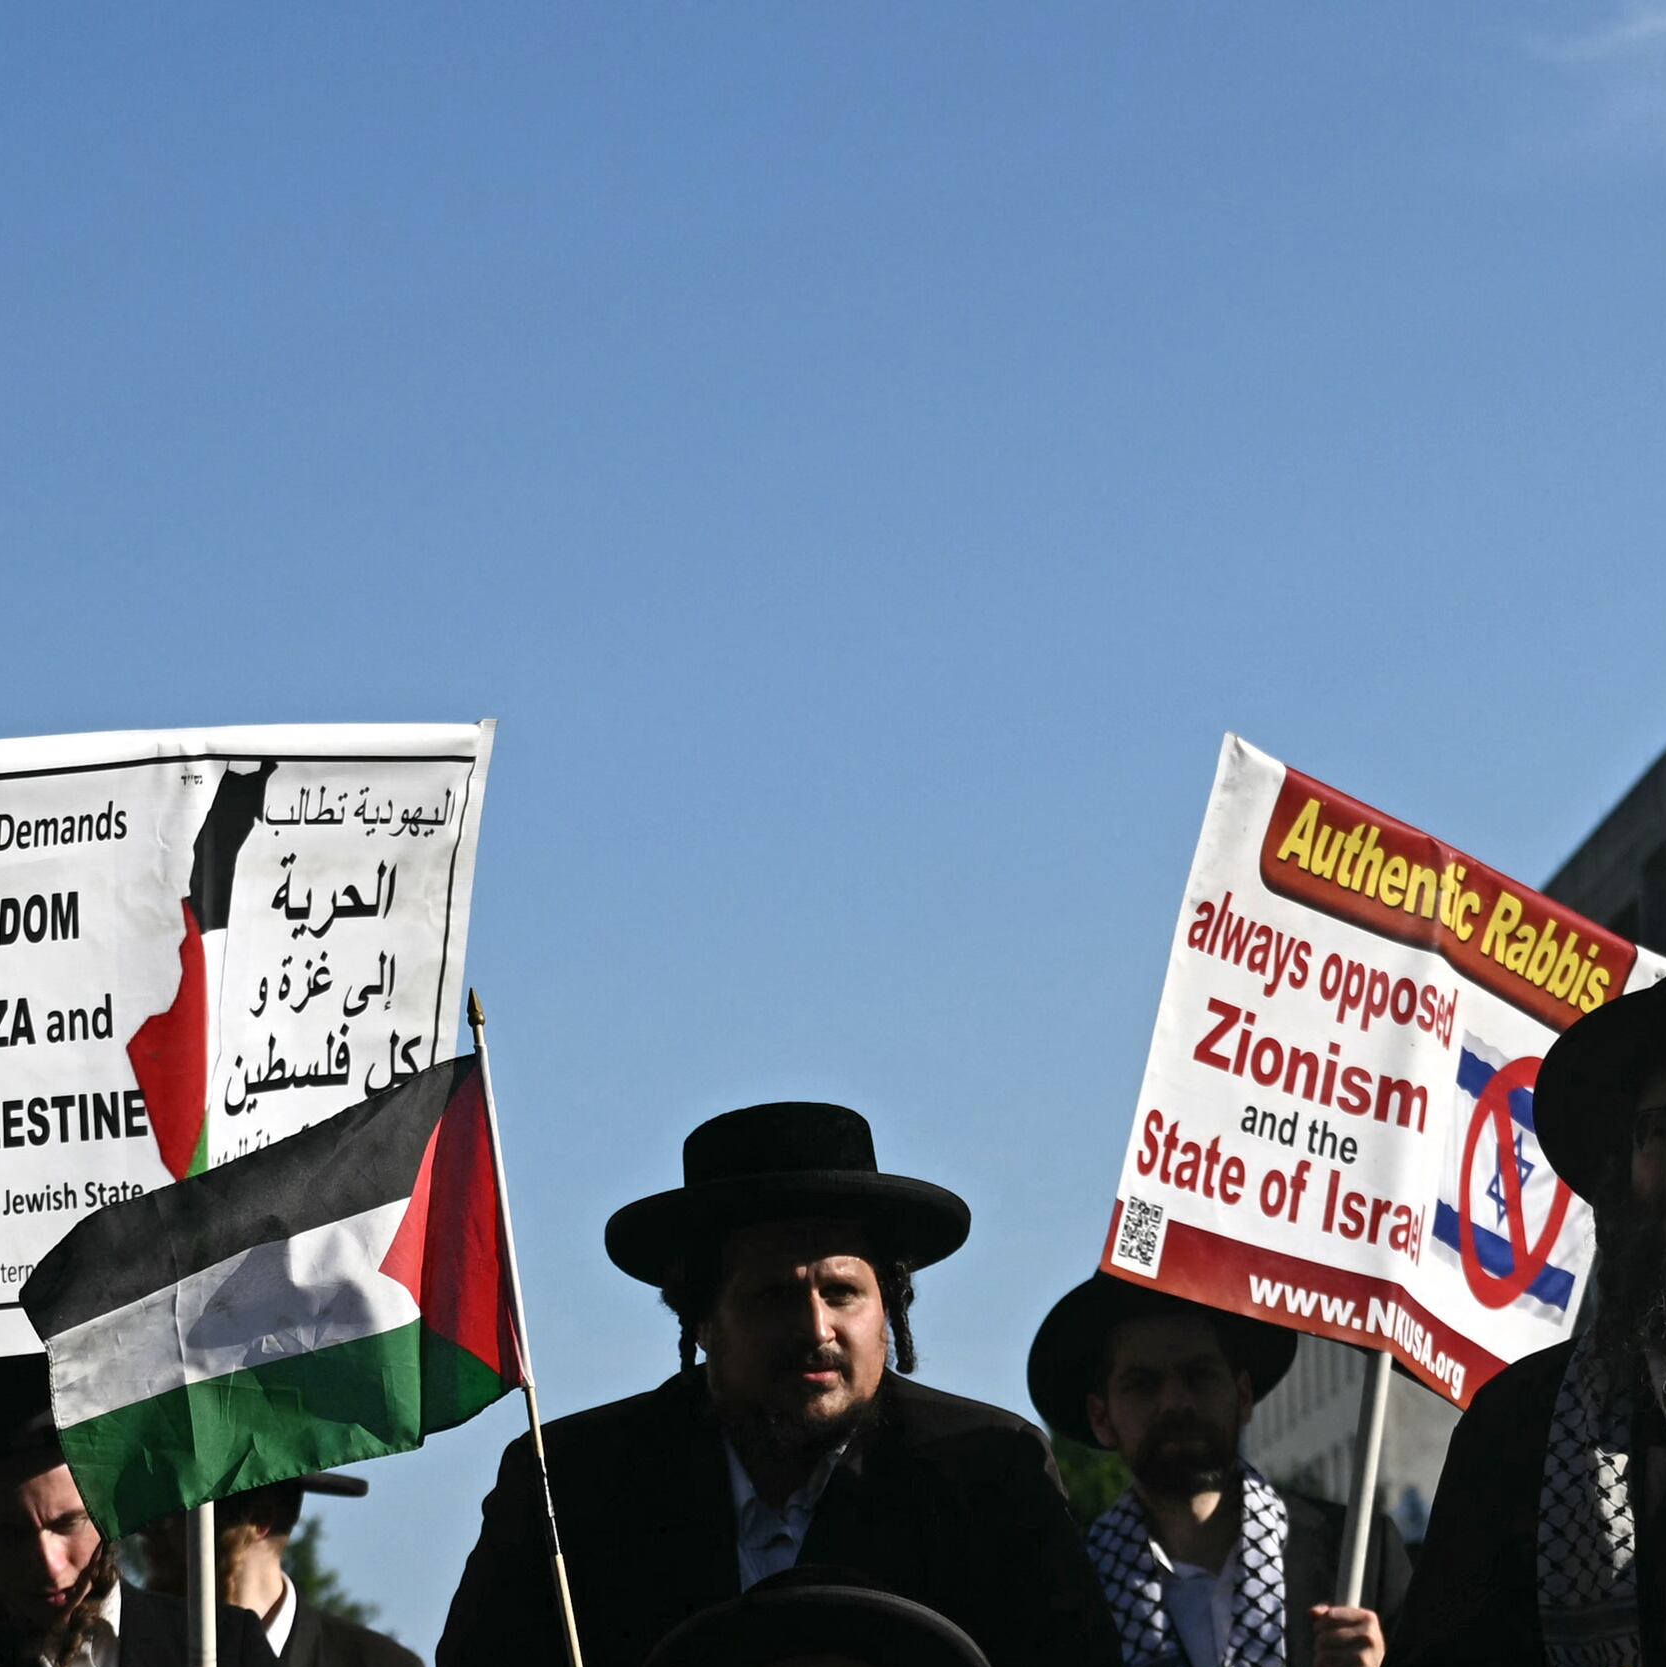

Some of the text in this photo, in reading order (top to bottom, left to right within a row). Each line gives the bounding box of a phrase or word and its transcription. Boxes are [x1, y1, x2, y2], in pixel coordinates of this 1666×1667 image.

[265, 785, 456, 837] اليهودية تطالب
[271, 852, 397, 940] الحرية
[1276, 798, 1611, 1015] Authentic Rabbis
[278, 951, 333, 1013] غزة
[343, 951, 395, 1017] إلى
[1188, 891, 1458, 1050] always opposed
[45, 993, 113, 1046] and
[224, 1023, 351, 1116] فلسطين
[1193, 998, 1430, 1133] Zionism
[1240, 1104, 1358, 1165] and the
[3, 1182, 77, 1216] Jewish
[84, 1180, 143, 1208] State
[1136, 1109, 1426, 1267] State of Israel
[1250, 1274, 1465, 1399] www.NKUSA.org
